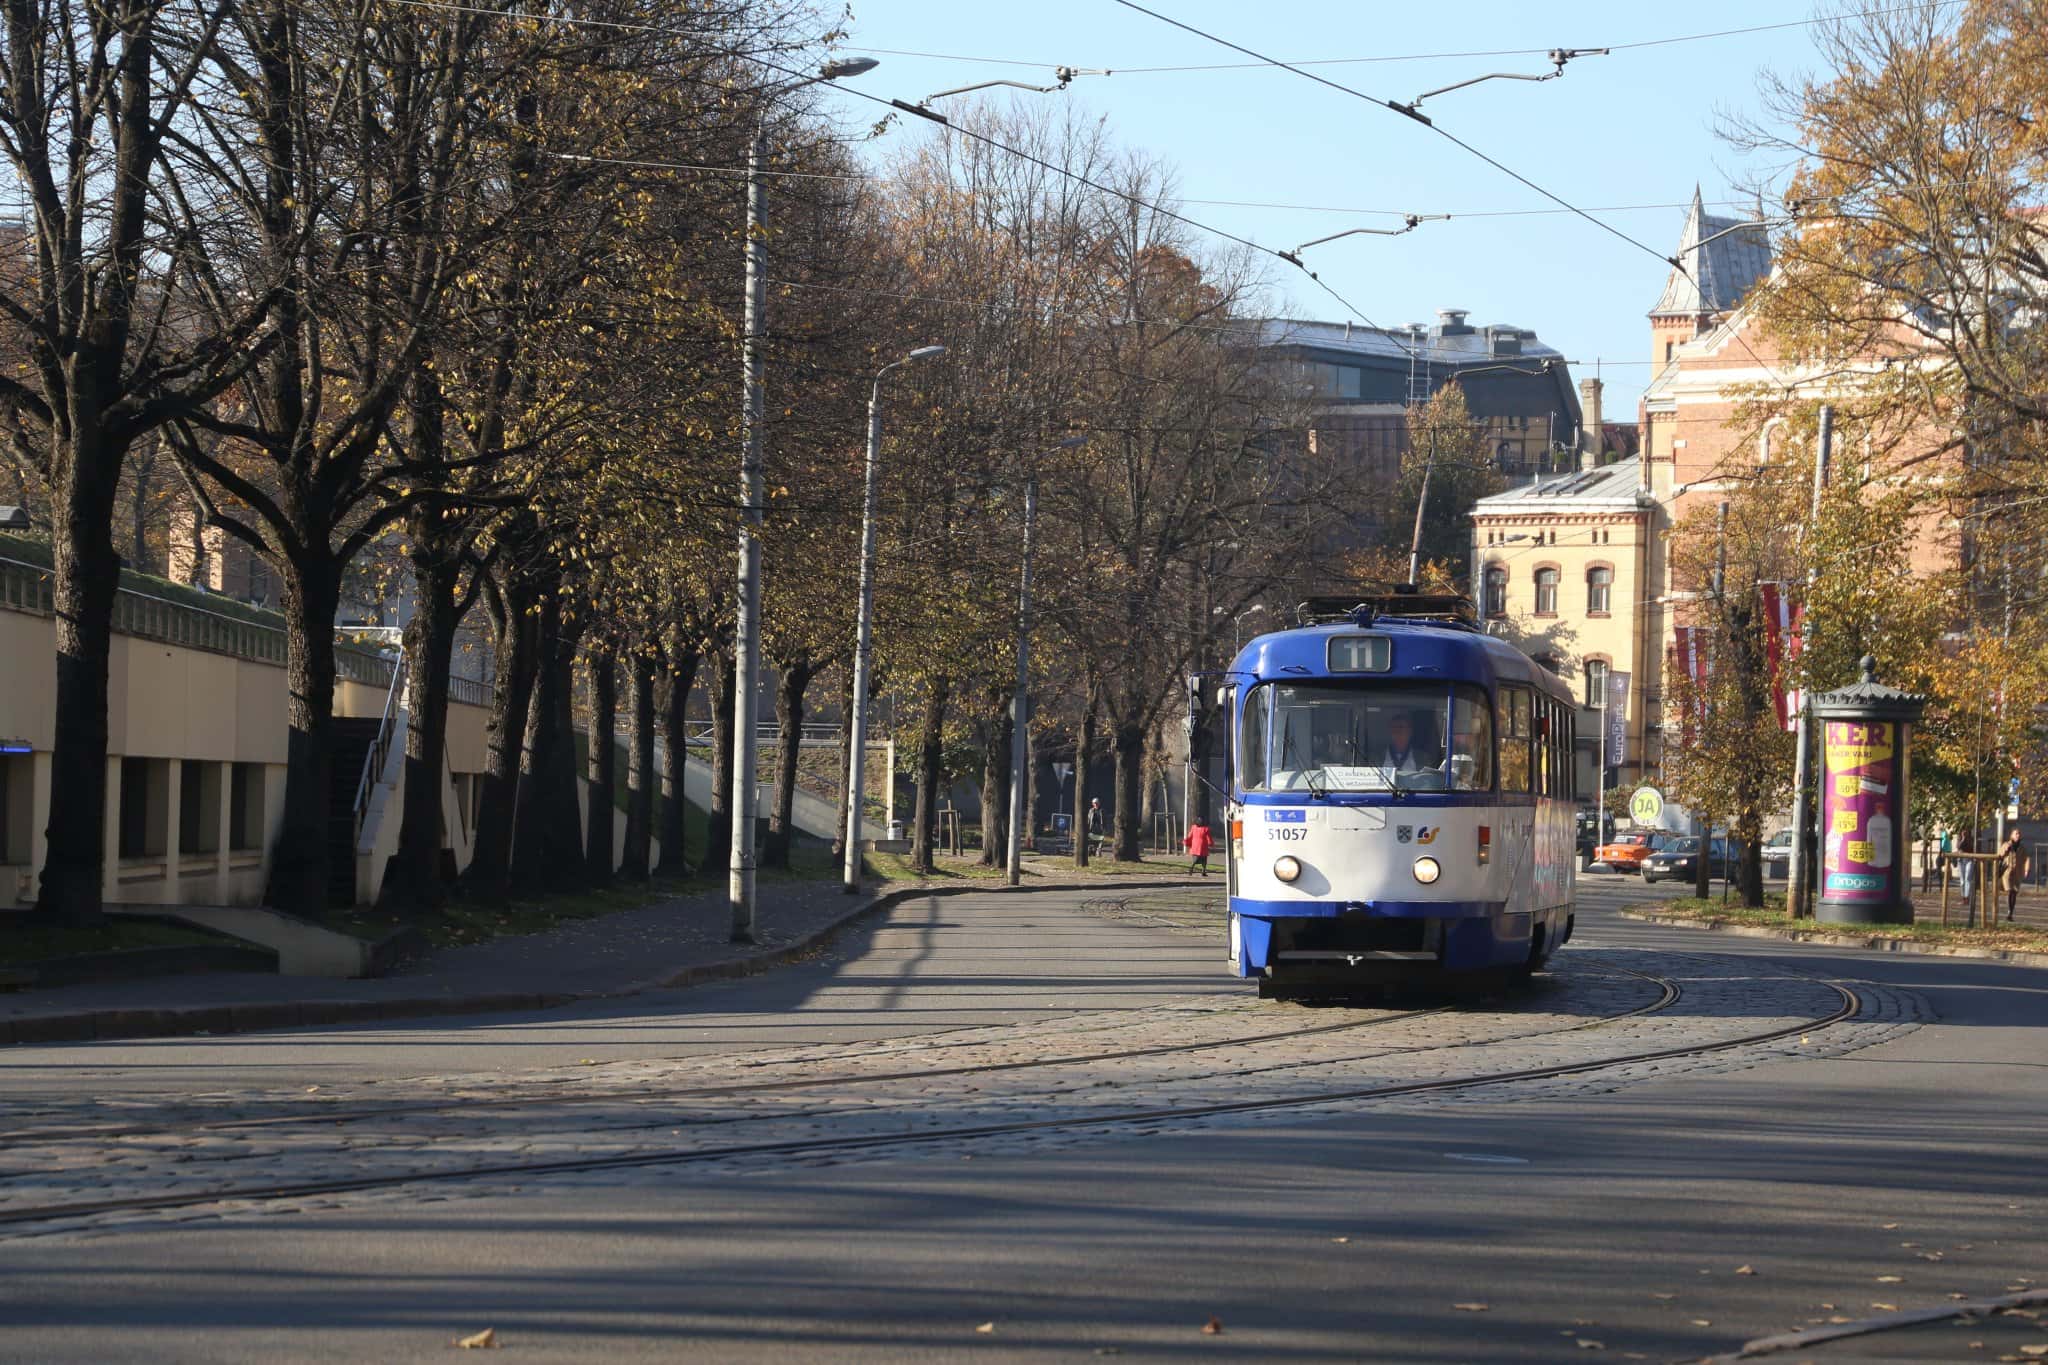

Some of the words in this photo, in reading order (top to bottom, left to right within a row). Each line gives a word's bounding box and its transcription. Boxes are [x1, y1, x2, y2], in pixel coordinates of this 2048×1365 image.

[1343, 639, 1372, 669] 11
[1637, 798, 1655, 814] JA
[1267, 827, 1308, 841] 51057
